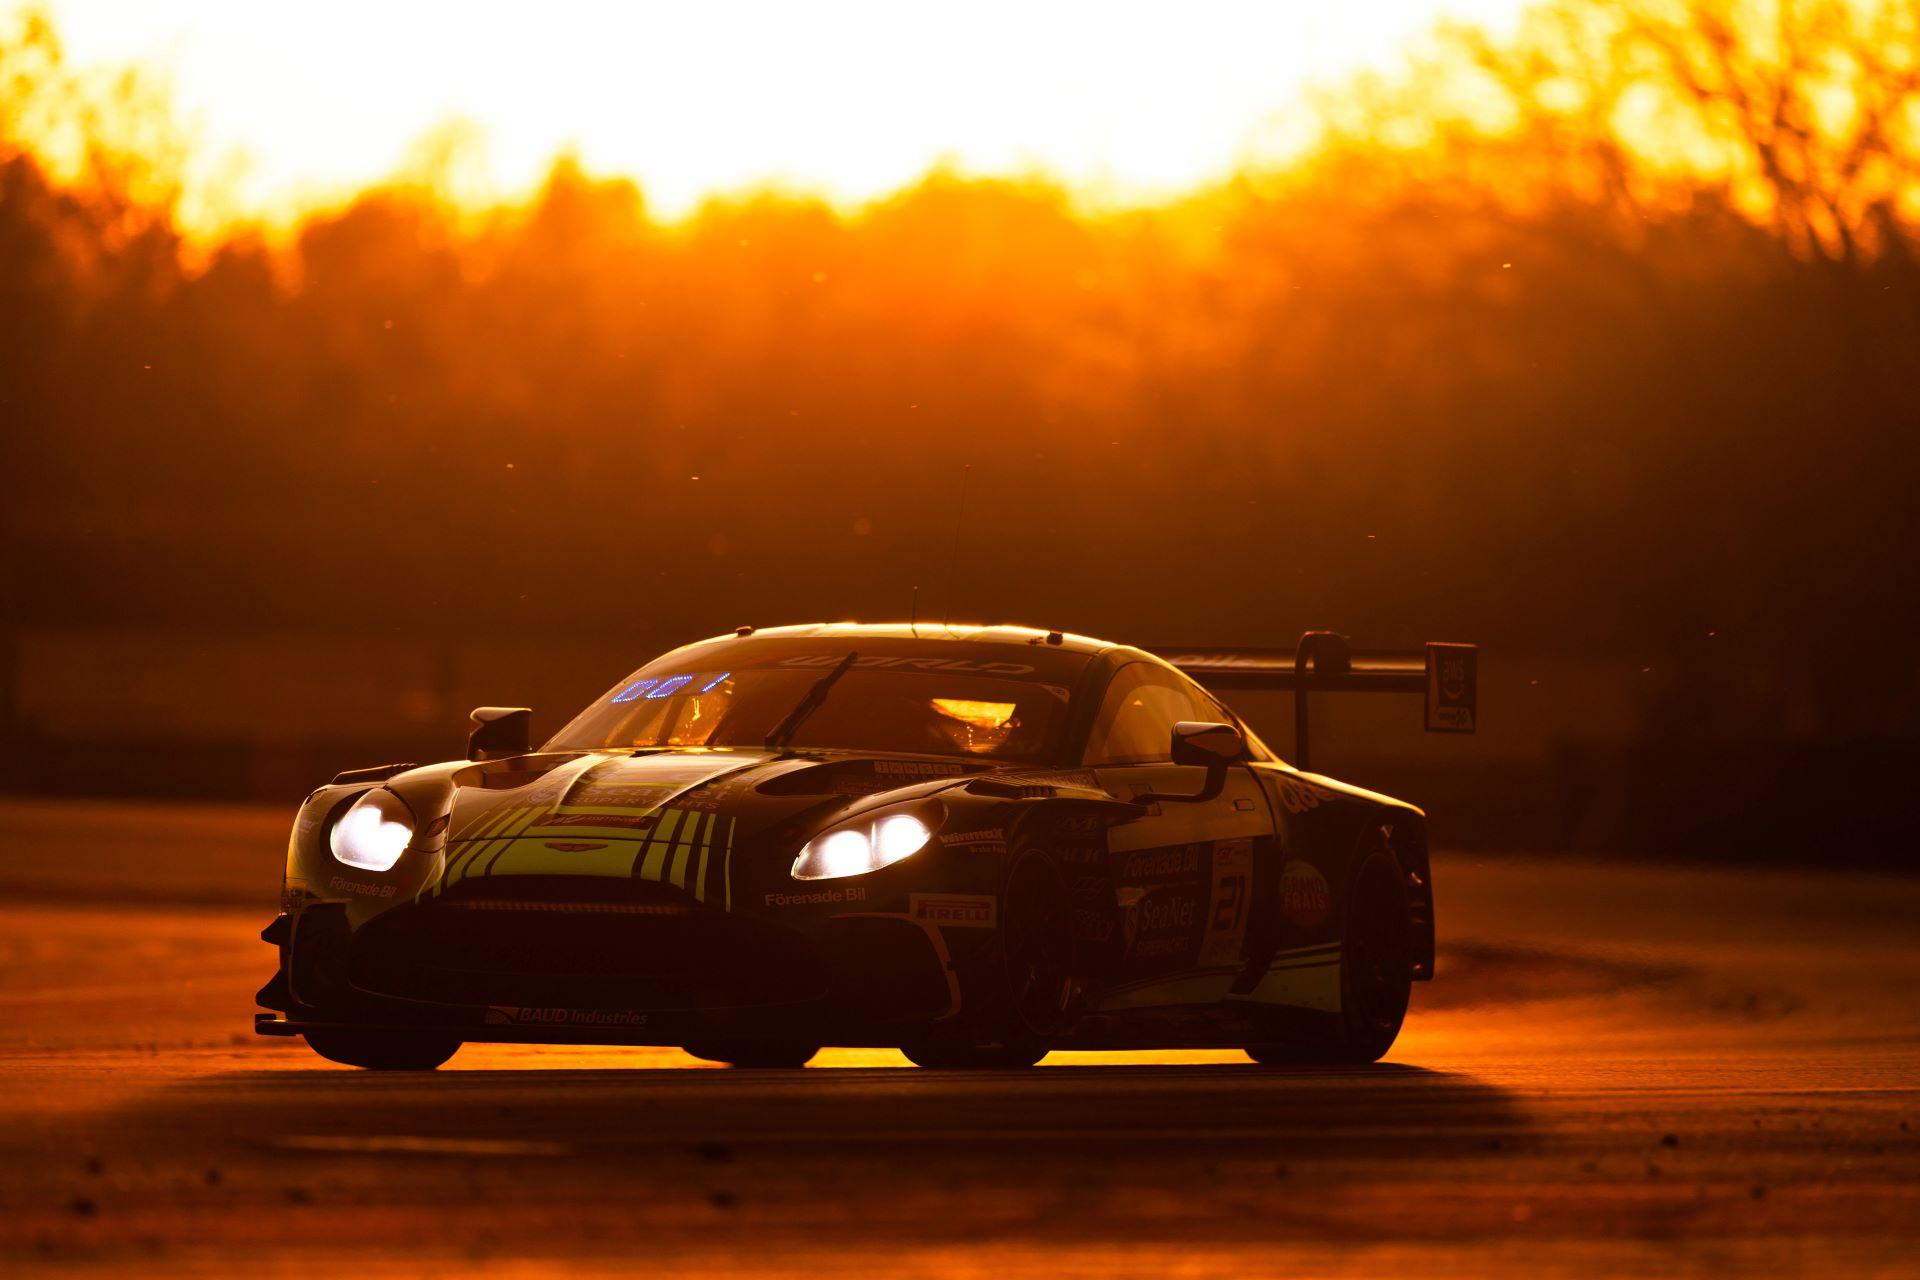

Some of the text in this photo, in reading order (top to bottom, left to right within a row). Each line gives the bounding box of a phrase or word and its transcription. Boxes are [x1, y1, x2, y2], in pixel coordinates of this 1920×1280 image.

[776, 654, 1035, 675] WORLD
[380, 885, 397, 898] Bil
[764, 888, 865, 906] Förenade Bil
[1284, 891, 1326, 910] FRAIS
[917, 900, 990, 921] PIRELLI
[1212, 876, 1245, 929] 21
[1143, 897, 1194, 929] SeaNet
[520, 1007, 648, 1025] BAUD Industries
